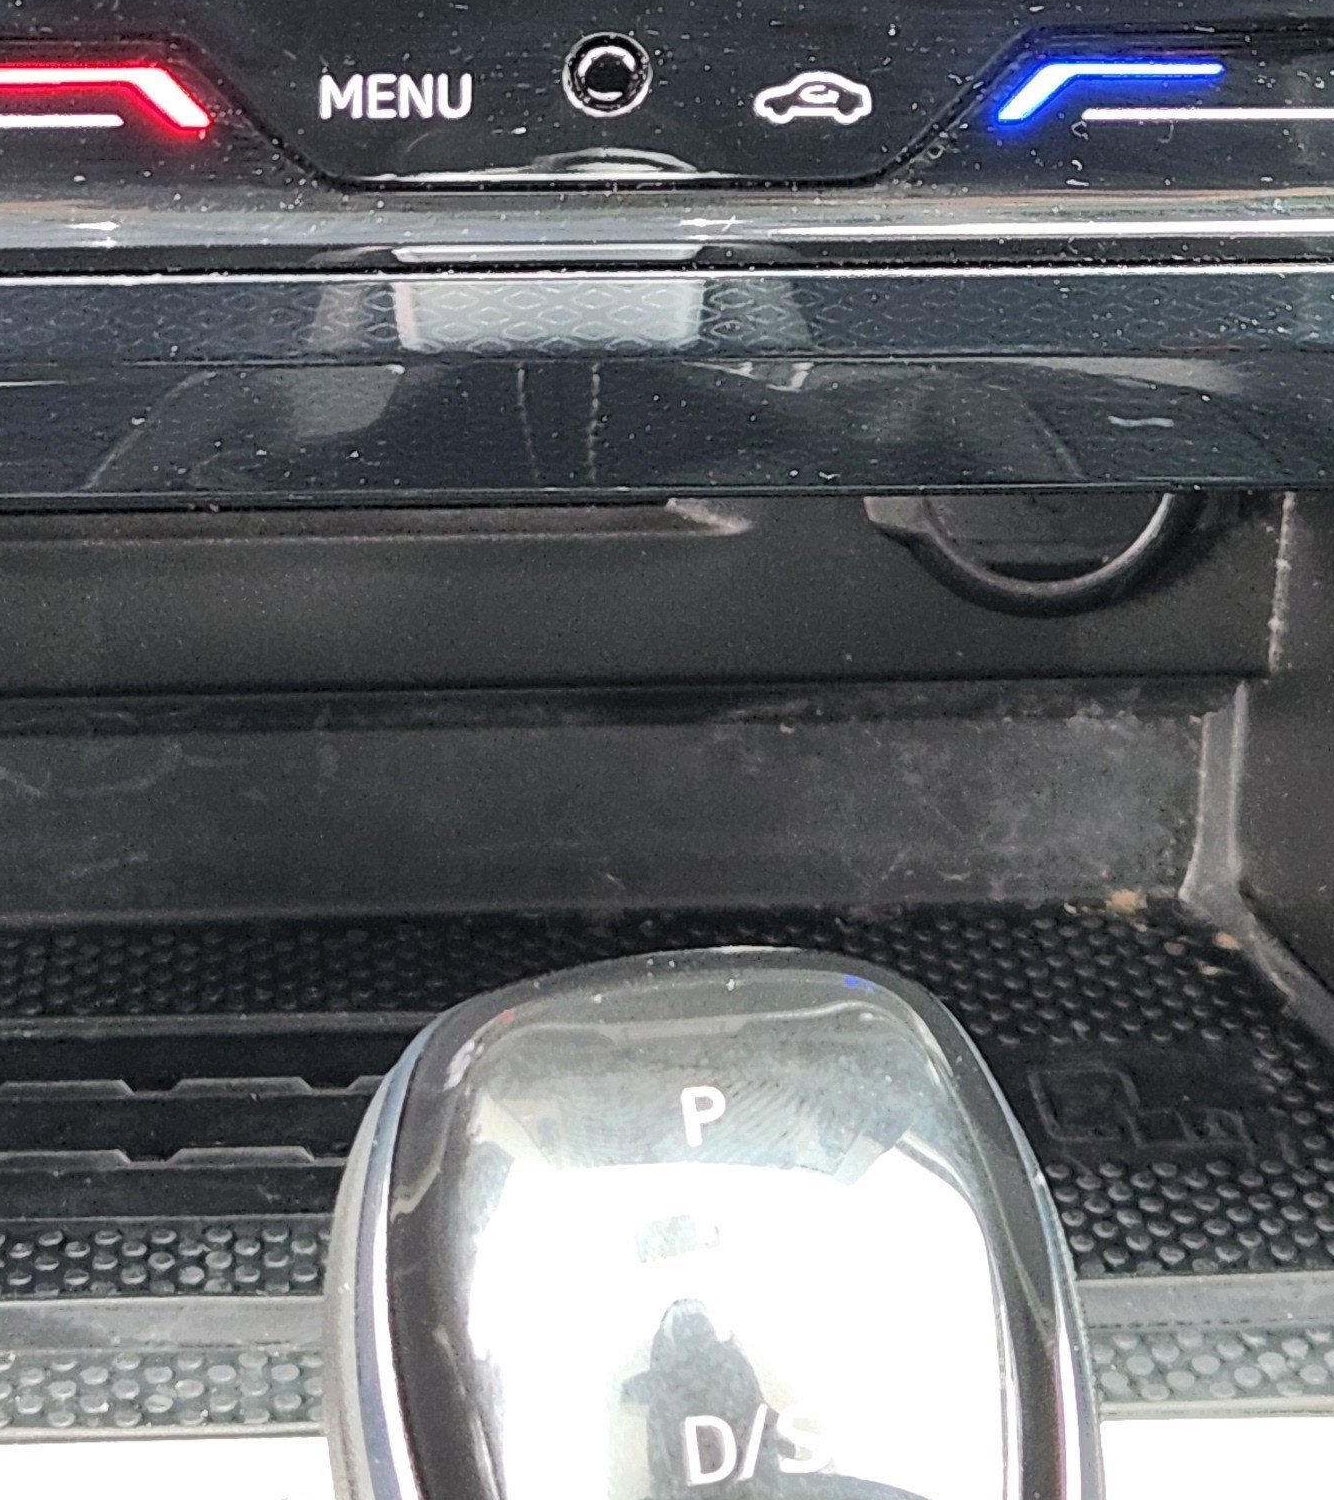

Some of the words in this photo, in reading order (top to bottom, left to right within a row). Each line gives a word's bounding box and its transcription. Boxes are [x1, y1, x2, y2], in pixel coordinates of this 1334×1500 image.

[319, 73, 473, 121] MENU
[679, 1084, 726, 1148] P
[681, 1402, 833, 1487] D/S
